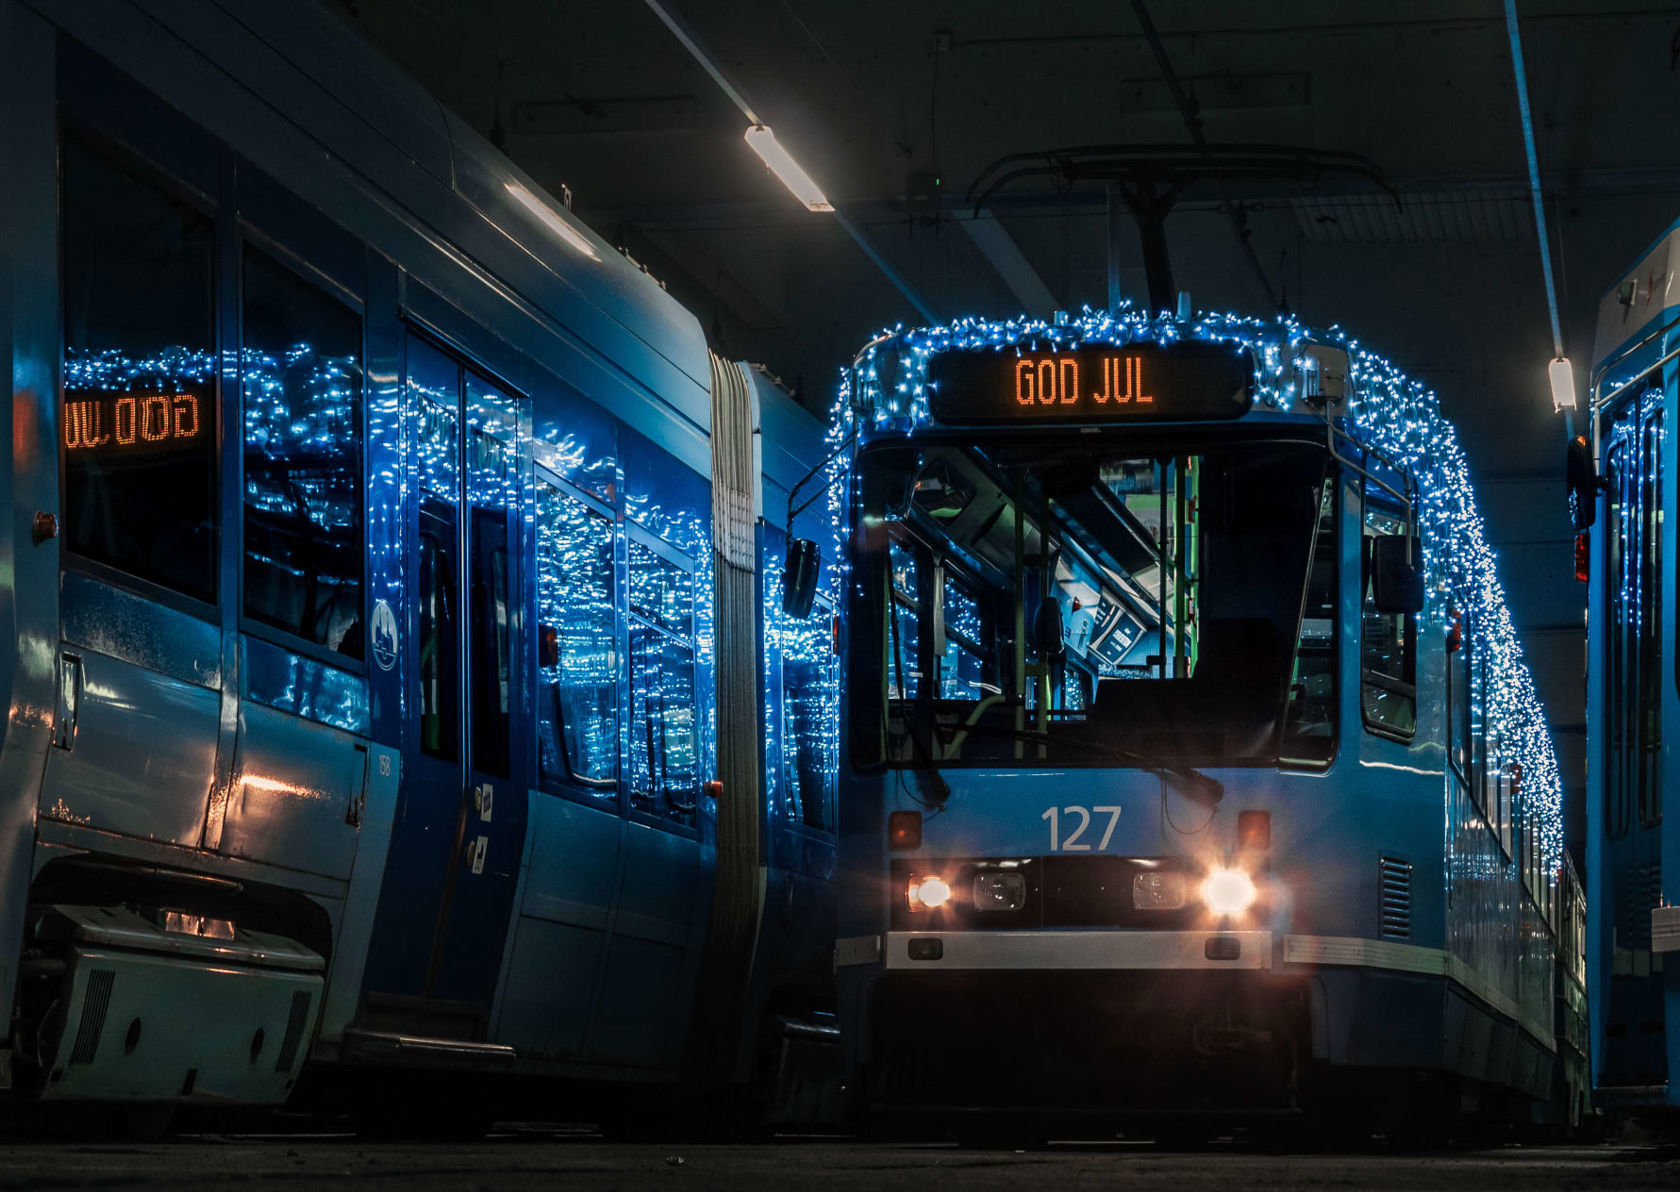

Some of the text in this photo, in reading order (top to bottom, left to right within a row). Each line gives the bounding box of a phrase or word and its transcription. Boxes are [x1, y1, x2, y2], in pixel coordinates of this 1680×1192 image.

[1016, 357, 1152, 405] GOD JUL
[1041, 805, 1122, 851] 127
